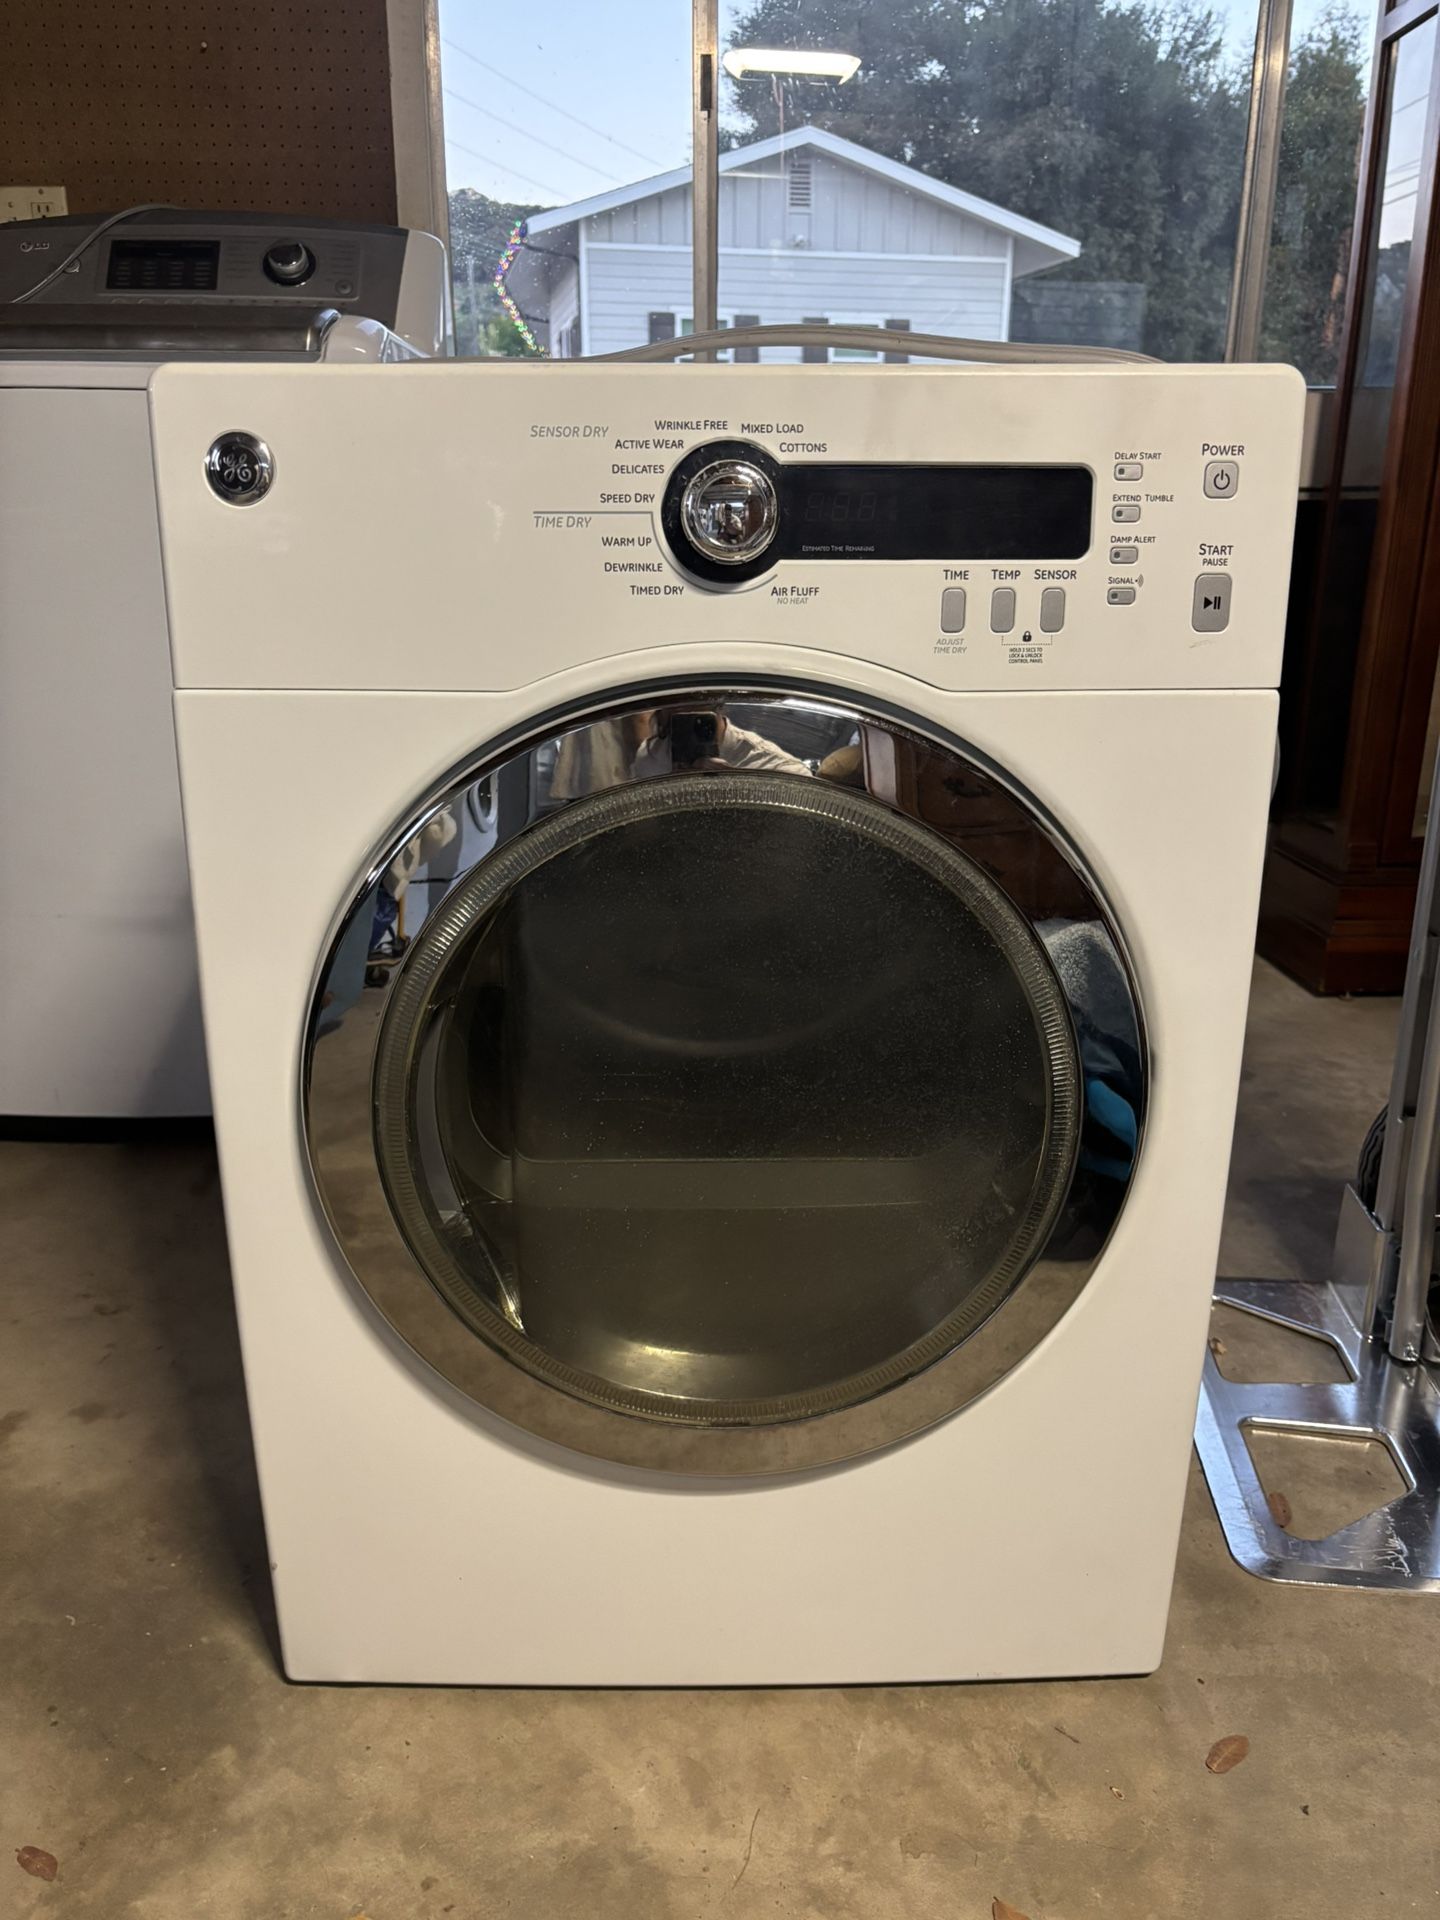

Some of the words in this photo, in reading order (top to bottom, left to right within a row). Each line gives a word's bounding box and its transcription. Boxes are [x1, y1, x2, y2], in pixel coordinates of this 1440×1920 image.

[654, 420, 702, 431] WRINKLE
[703, 420, 728, 431] FREE
[741, 423, 773, 434] MIXED
[775, 423, 804, 434] LOAD
[530, 425, 581, 438] SENSOR
[583, 425, 609, 438] DRY
[614, 438, 651, 450] ACTIVE
[652, 438, 684, 450] WEAR
[779, 442, 828, 453] COTTONS
[1201, 444, 1245, 456] POWER
[1114, 452, 1138, 461] DELAY
[1139, 452, 1162, 461] START
[611, 464, 665, 474] DELICATES
[599, 493, 632, 504] SPEED
[634, 493, 655, 504] DRY
[1112, 494, 1142, 502] EXTEND
[1145, 494, 1174, 502] TUMBLE
[533, 516, 563, 528] TIME
[565, 516, 592, 528] DRY
[601, 536, 635, 547] WARM
[638, 536, 652, 547] UP
[1110, 536, 1132, 544] DAMP
[1133, 536, 1156, 544] ALERT
[1198, 543, 1234, 556] START
[604, 562, 663, 573] DEWRINKLE
[1202, 558, 1228, 567] PAUSE
[943, 569, 970, 580] TIME
[991, 569, 1021, 580] TEMP
[1034, 569, 1077, 580] SENSOR
[1108, 577, 1135, 585] SIGNAL
[629, 585, 661, 596] TIMED
[663, 585, 684, 596] DRY
[770, 586, 788, 597] AIR
[790, 586, 820, 597] FLUFF
[777, 597, 788, 605] NO
[789, 597, 809, 605] HEAT
